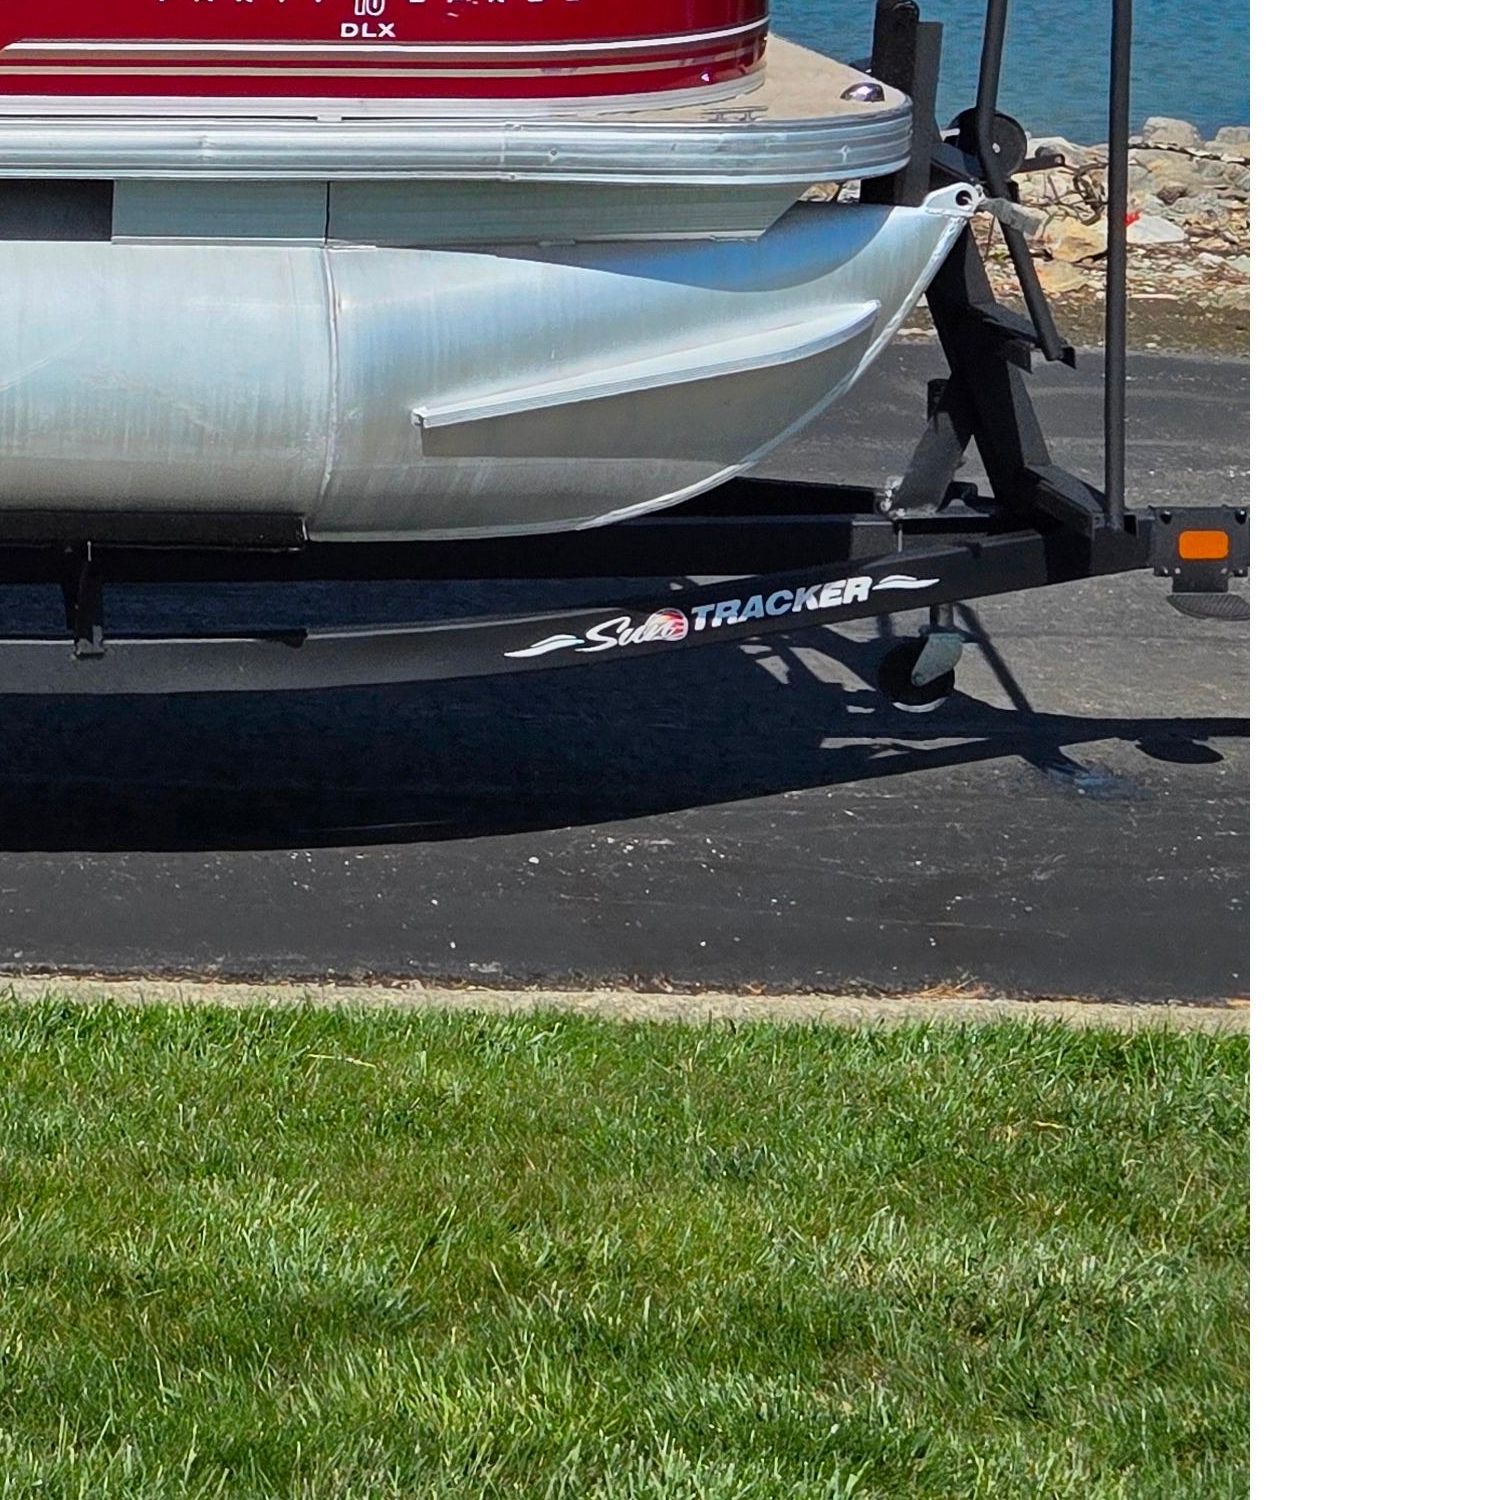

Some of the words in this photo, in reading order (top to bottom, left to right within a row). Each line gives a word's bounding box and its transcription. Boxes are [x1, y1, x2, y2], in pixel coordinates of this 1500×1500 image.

[340, 22, 396, 38] DLX
[574, 615, 680, 653] Sun
[690, 575, 873, 632] TRACKER
